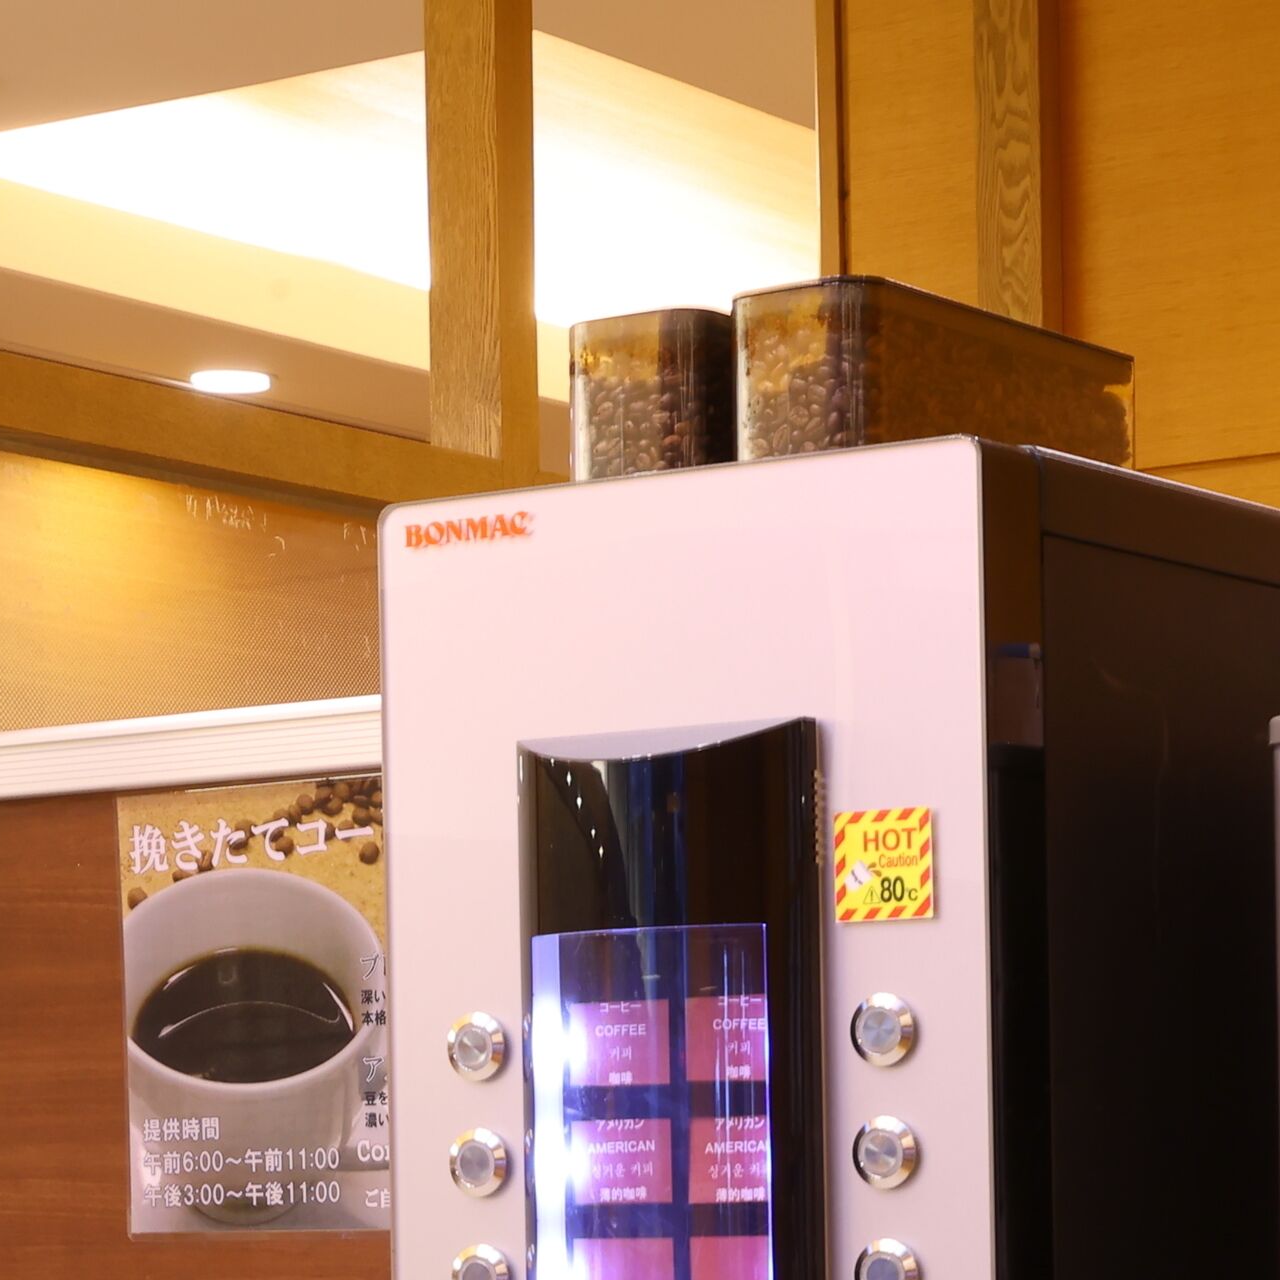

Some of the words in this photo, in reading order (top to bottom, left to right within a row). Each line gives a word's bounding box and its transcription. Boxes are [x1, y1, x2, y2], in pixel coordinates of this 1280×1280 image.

[405, 511, 532, 547] BONMAC
[129, 817, 374, 874] 挽きたてコー
[863, 828, 916, 852] HOT
[879, 853, 918, 868] Caution
[595, 1024, 646, 1037] COFFEE
[713, 1018, 767, 1031] COFFEE
[143, 1117, 220, 1142] 提供時間
[587, 1139, 655, 1154] AMERICAN
